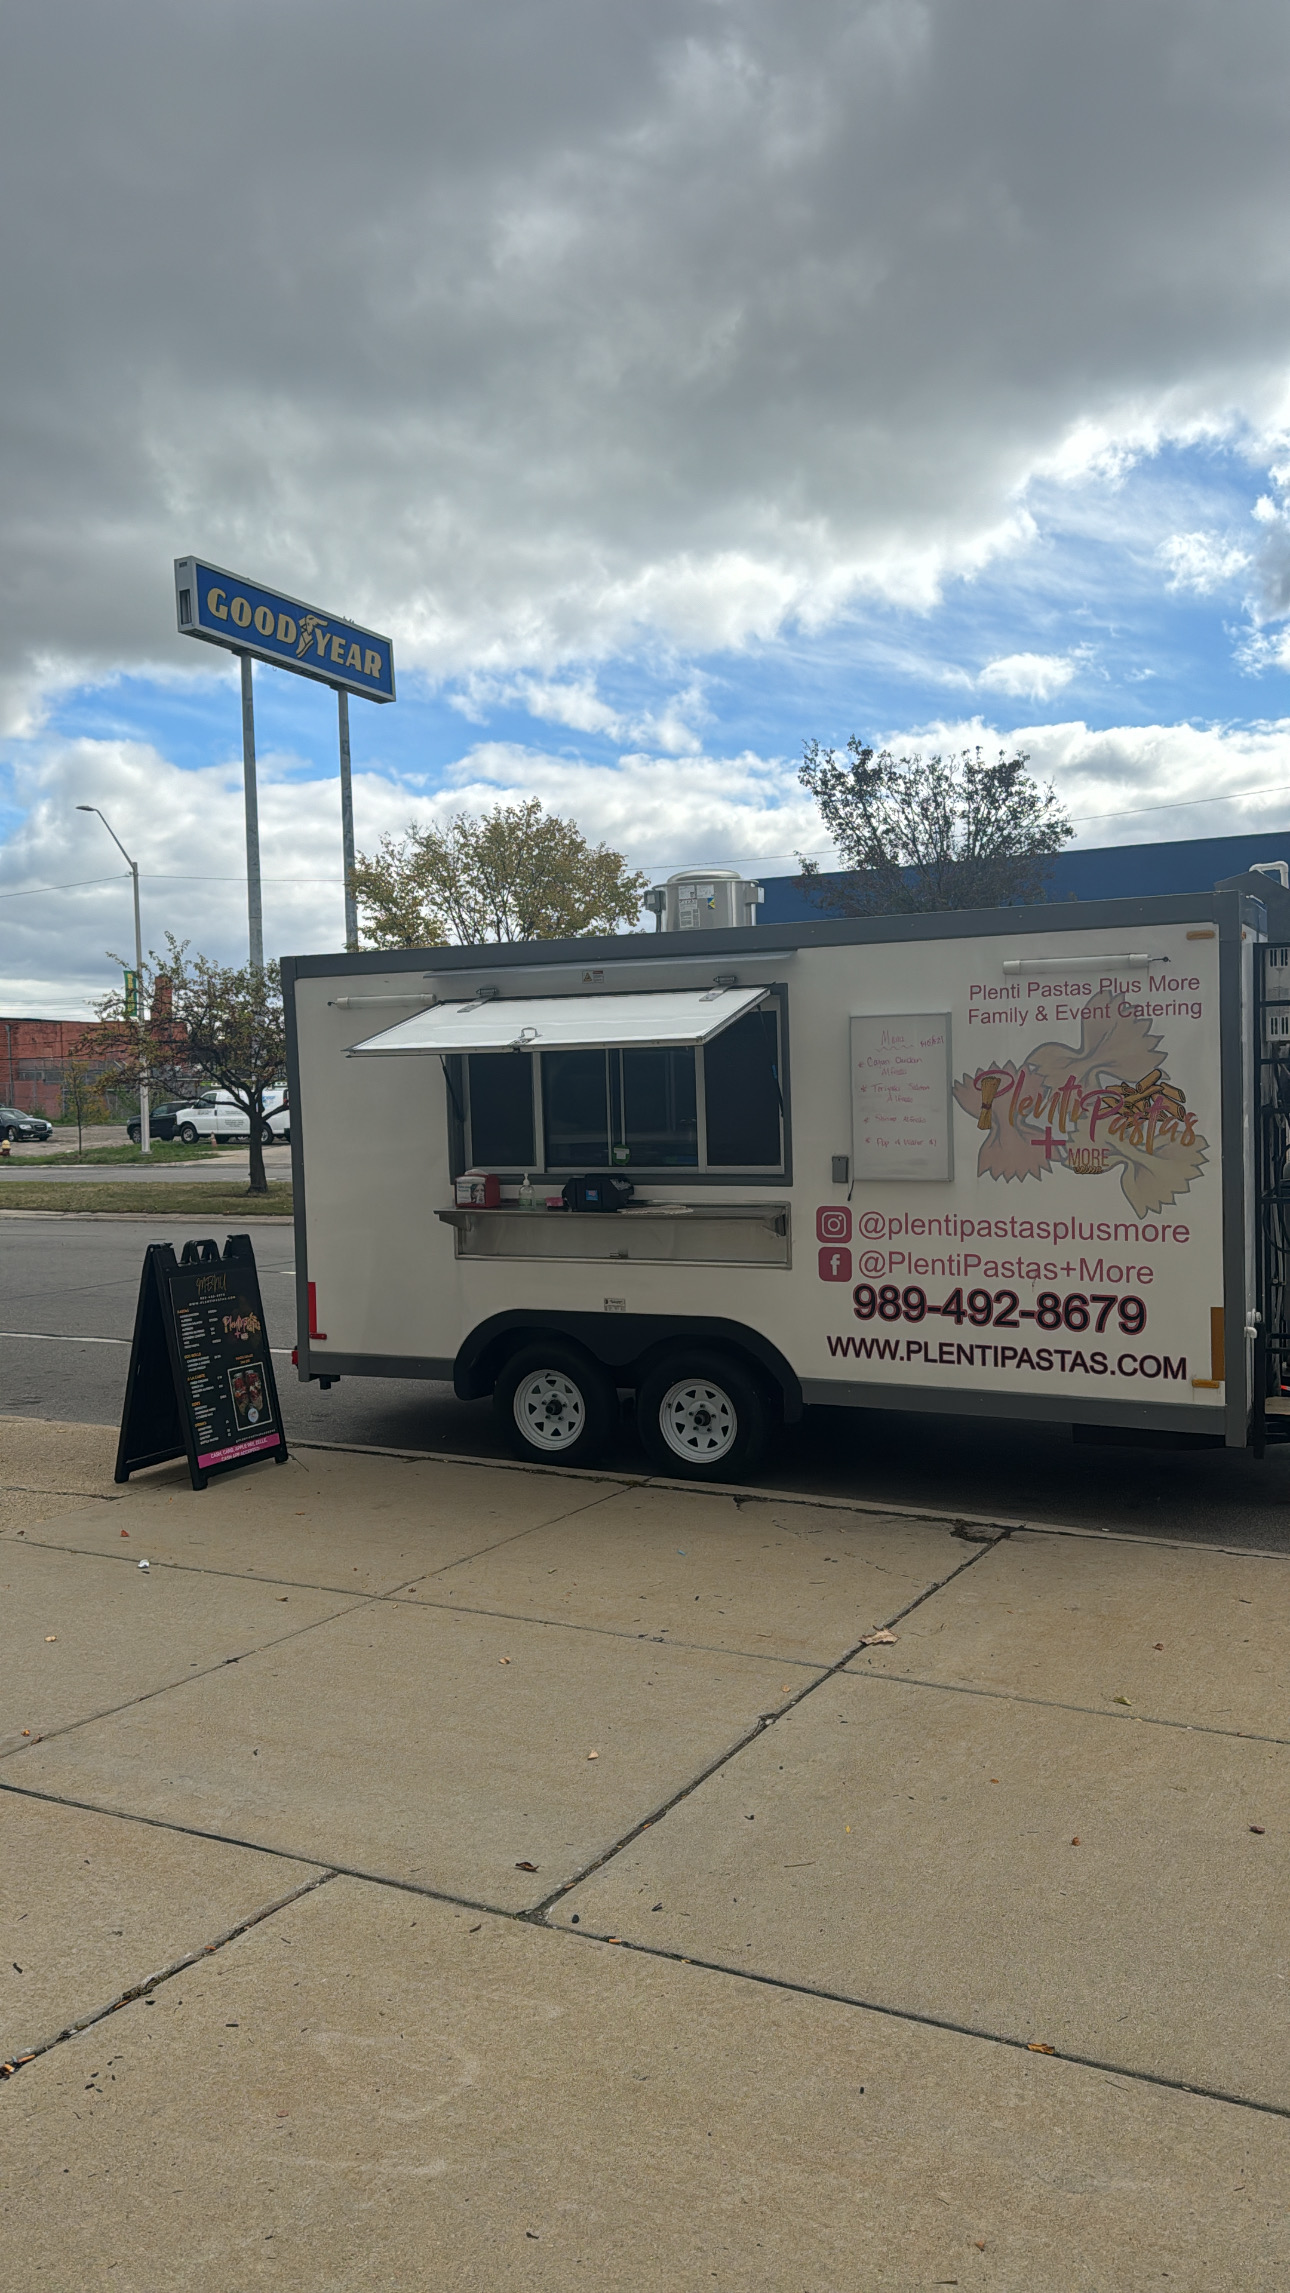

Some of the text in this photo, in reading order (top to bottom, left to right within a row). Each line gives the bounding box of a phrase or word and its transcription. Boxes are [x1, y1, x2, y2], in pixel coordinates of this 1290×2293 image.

[207, 587, 382, 679] GOODYEAR
[969, 975, 1201, 1001] Plenti Pastas Plus More
[968, 1000, 1202, 1026] Family & Event Catering
[974, 1070, 1199, 1155] Plenti Pastas
[1068, 1148, 1109, 1166] MORE
[858, 1211, 1191, 1245] @plentipastasplusmore
[858, 1250, 1154, 1284] @PlentiPastas+More
[853, 1283, 1147, 1335] 989-492-8679
[827, 1335, 1187, 1380] WWW.PLENTIPASTAS.COM
